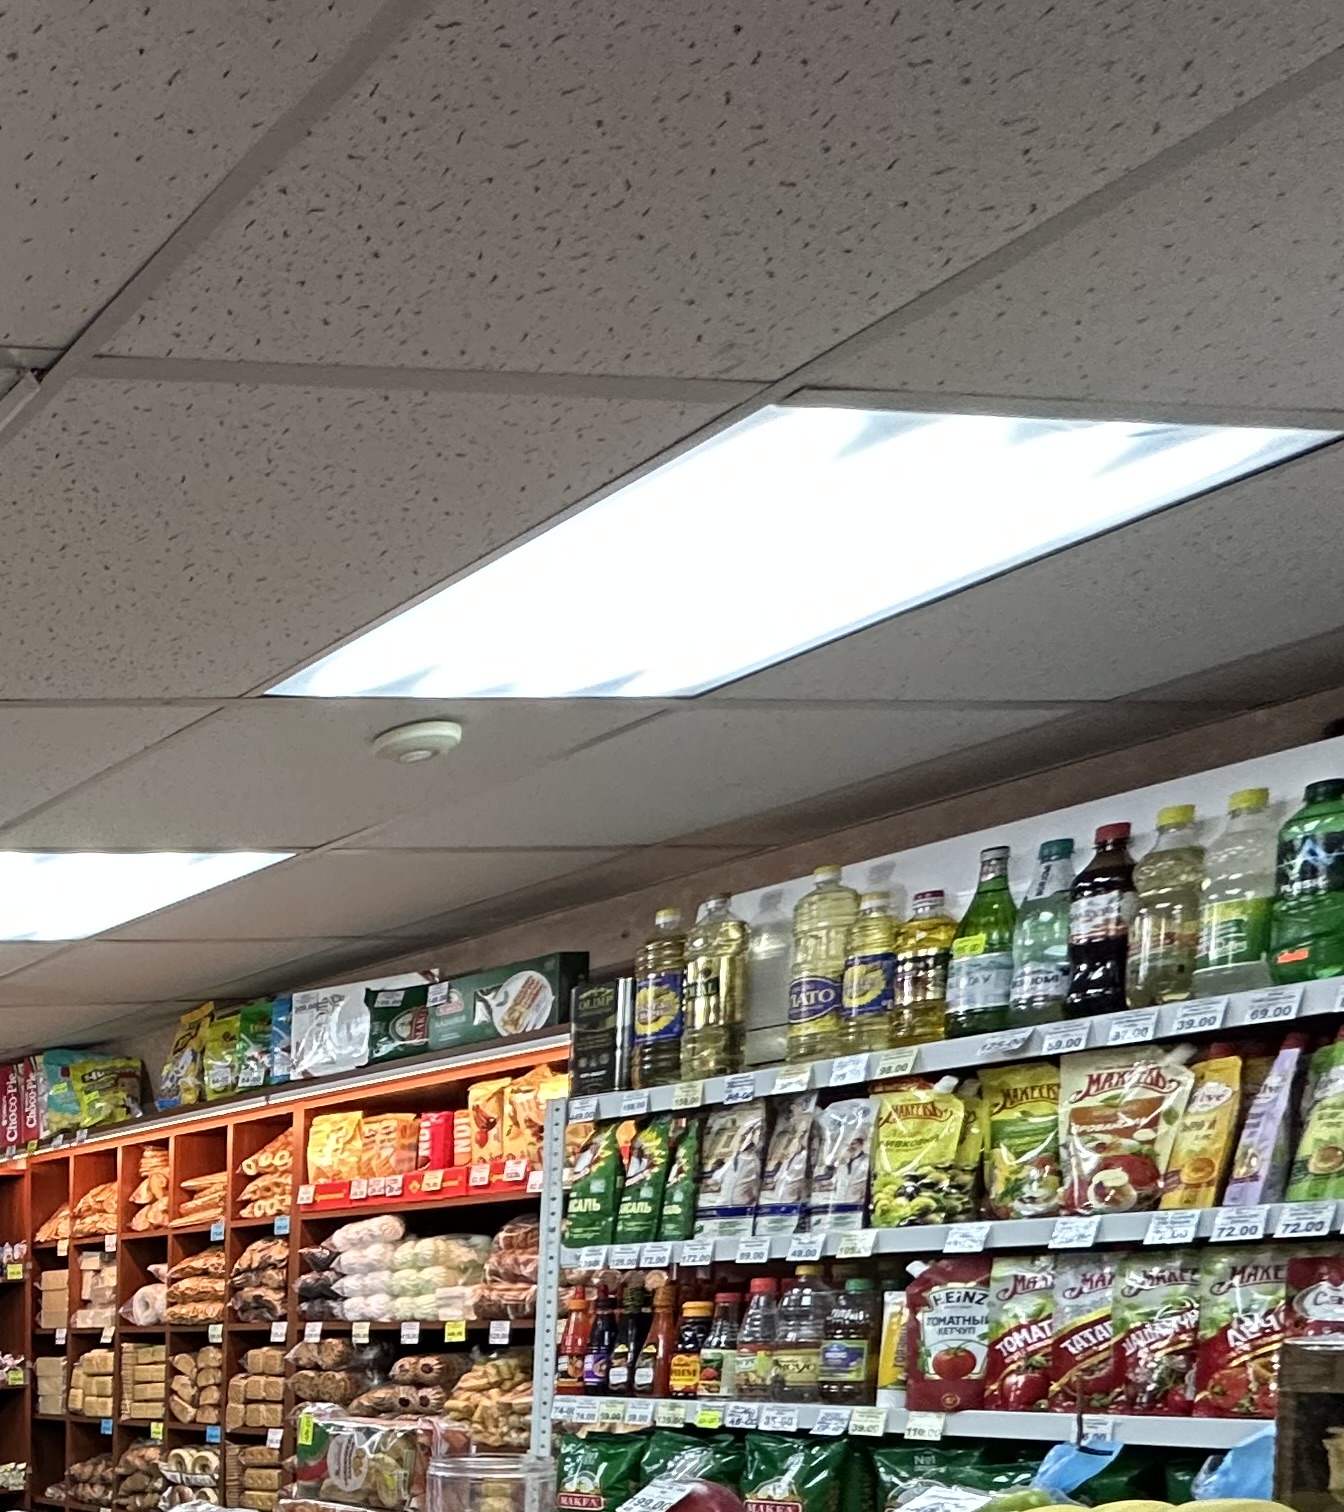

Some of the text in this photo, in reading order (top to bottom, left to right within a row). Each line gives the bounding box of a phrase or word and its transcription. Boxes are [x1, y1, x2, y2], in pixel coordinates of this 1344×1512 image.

[1250, 1006, 1292, 1021] 69.00
[1176, 1016, 1218, 1032] 39.00
[1217, 1225, 1258, 1237] 72.00
[1281, 1221, 1325, 1233] 72.00
[932, 1290, 989, 1306] HEINZ
